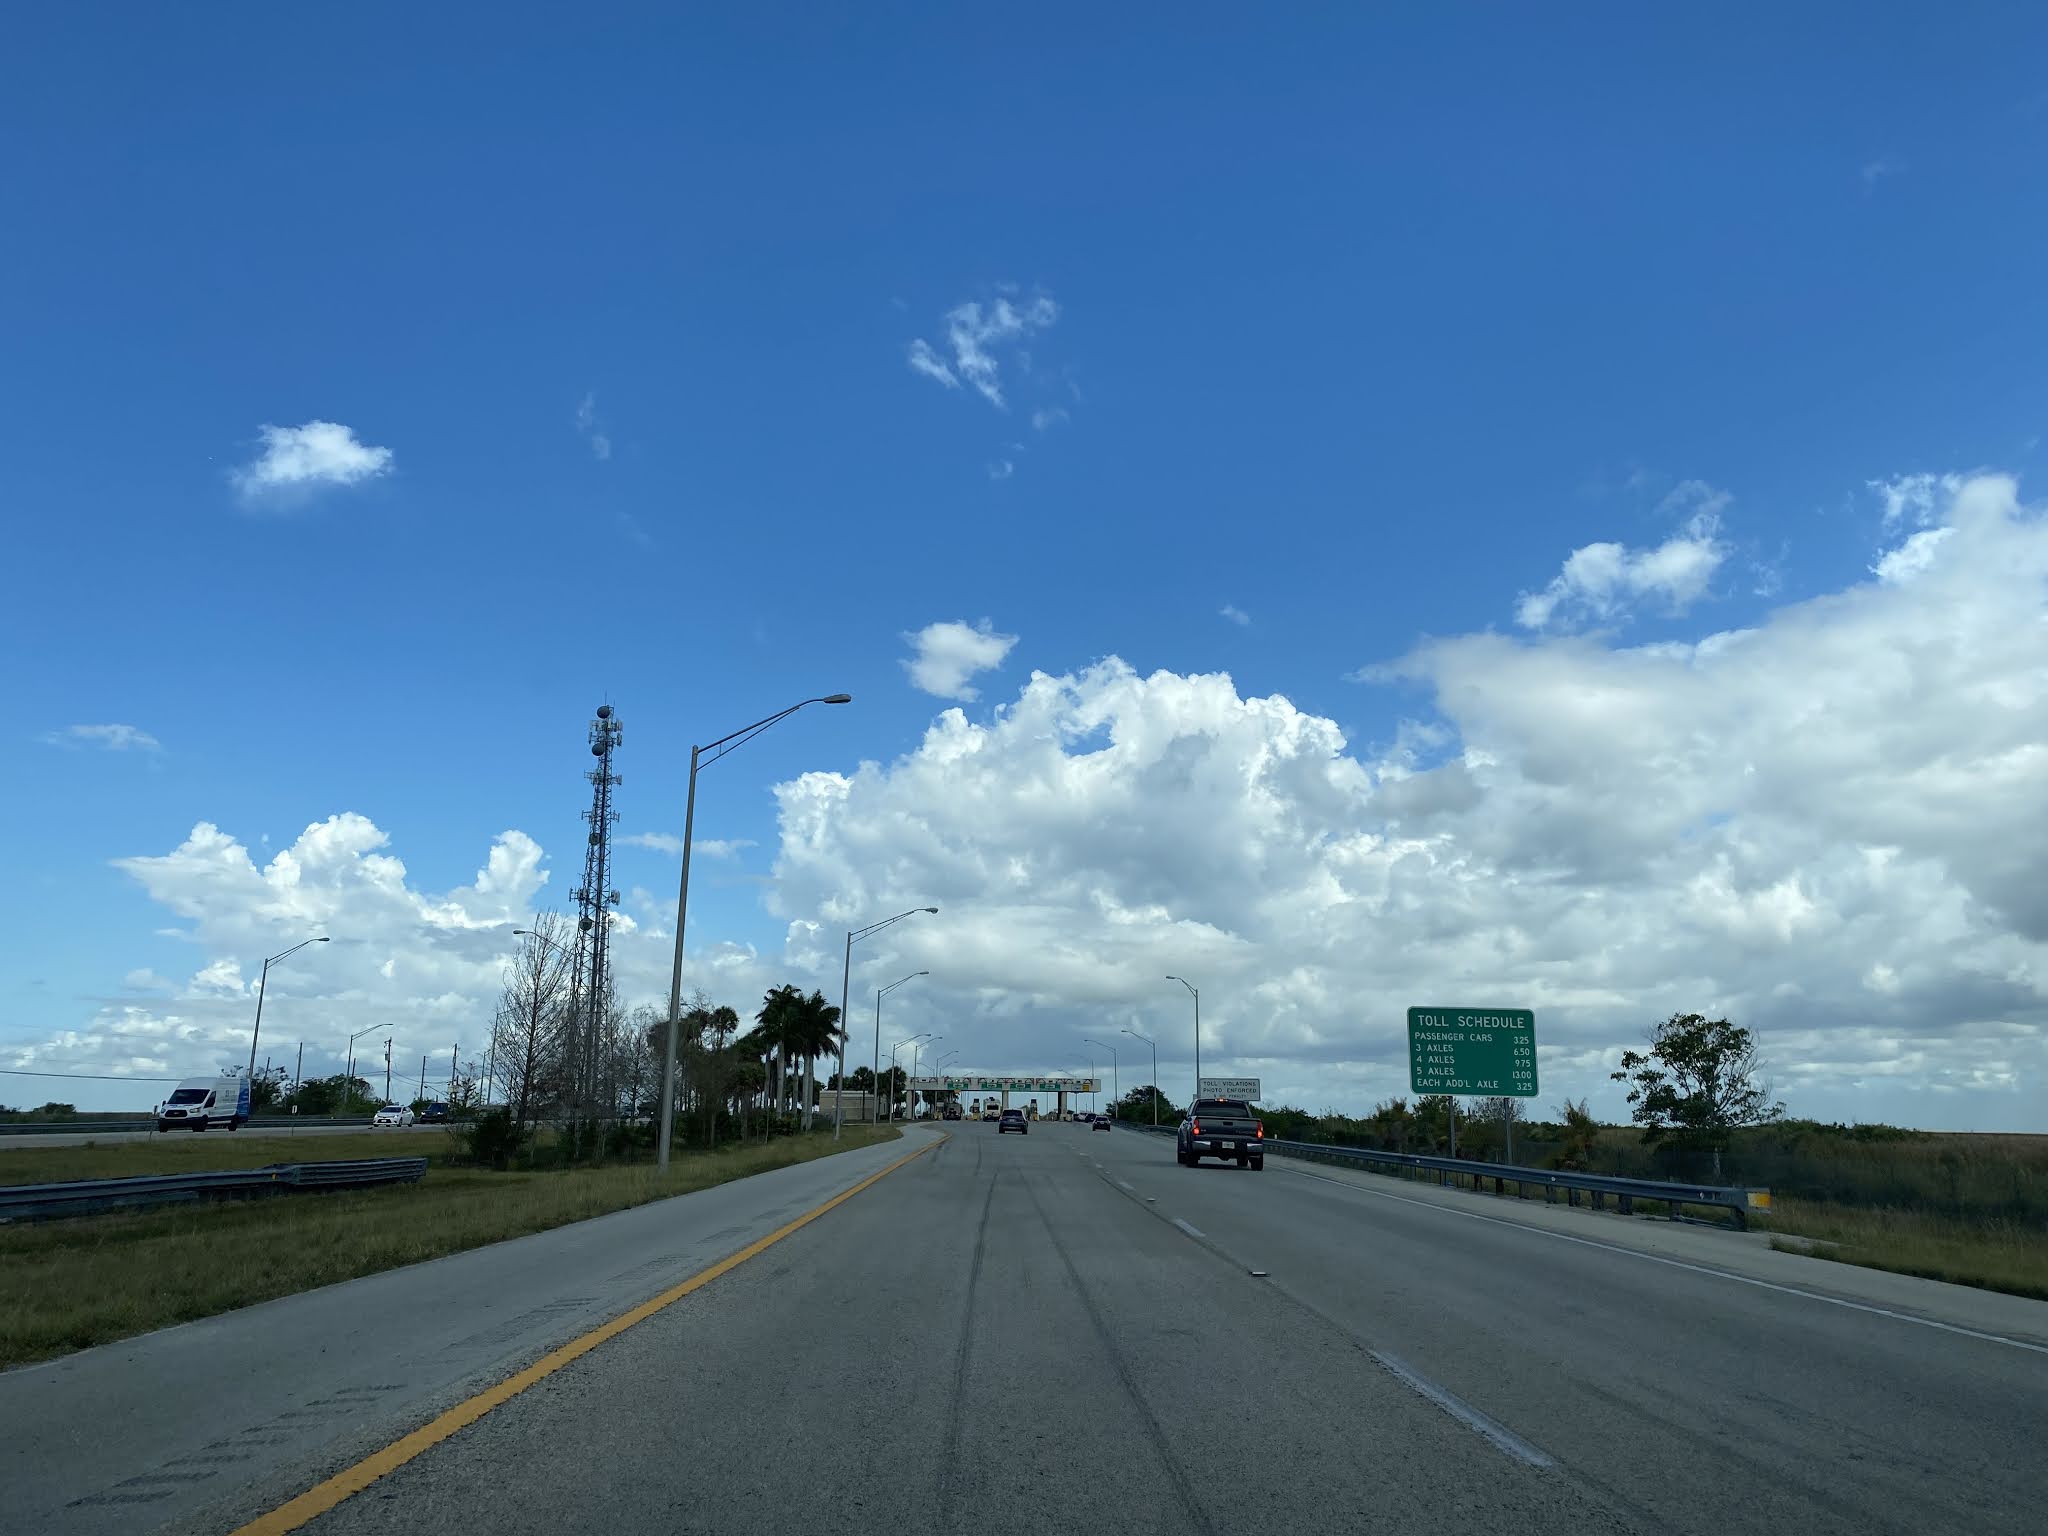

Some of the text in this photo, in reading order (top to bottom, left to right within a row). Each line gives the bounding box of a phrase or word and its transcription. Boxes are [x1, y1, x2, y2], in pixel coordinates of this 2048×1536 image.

[1418, 1015, 1525, 1028] TOLL SCHEDULE
[1415, 1032, 1493, 1042] PASSENGER CARS
[1514, 1036, 1529, 1045] 3.25
[1416, 1044, 1454, 1053] 3 AXLES
[1514, 1048, 1530, 1056] 6.50
[1428, 1056, 1455, 1064] AXLES
[1515, 1060, 1531, 1068] 9.75
[1416, 1067, 1455, 1076] 5 AXLES
[1512, 1071, 1532, 1079] 13.00
[1417, 1079, 1499, 1089] EACH ADD'L AXLE
[1517, 1083, 1533, 1091] 3.25
